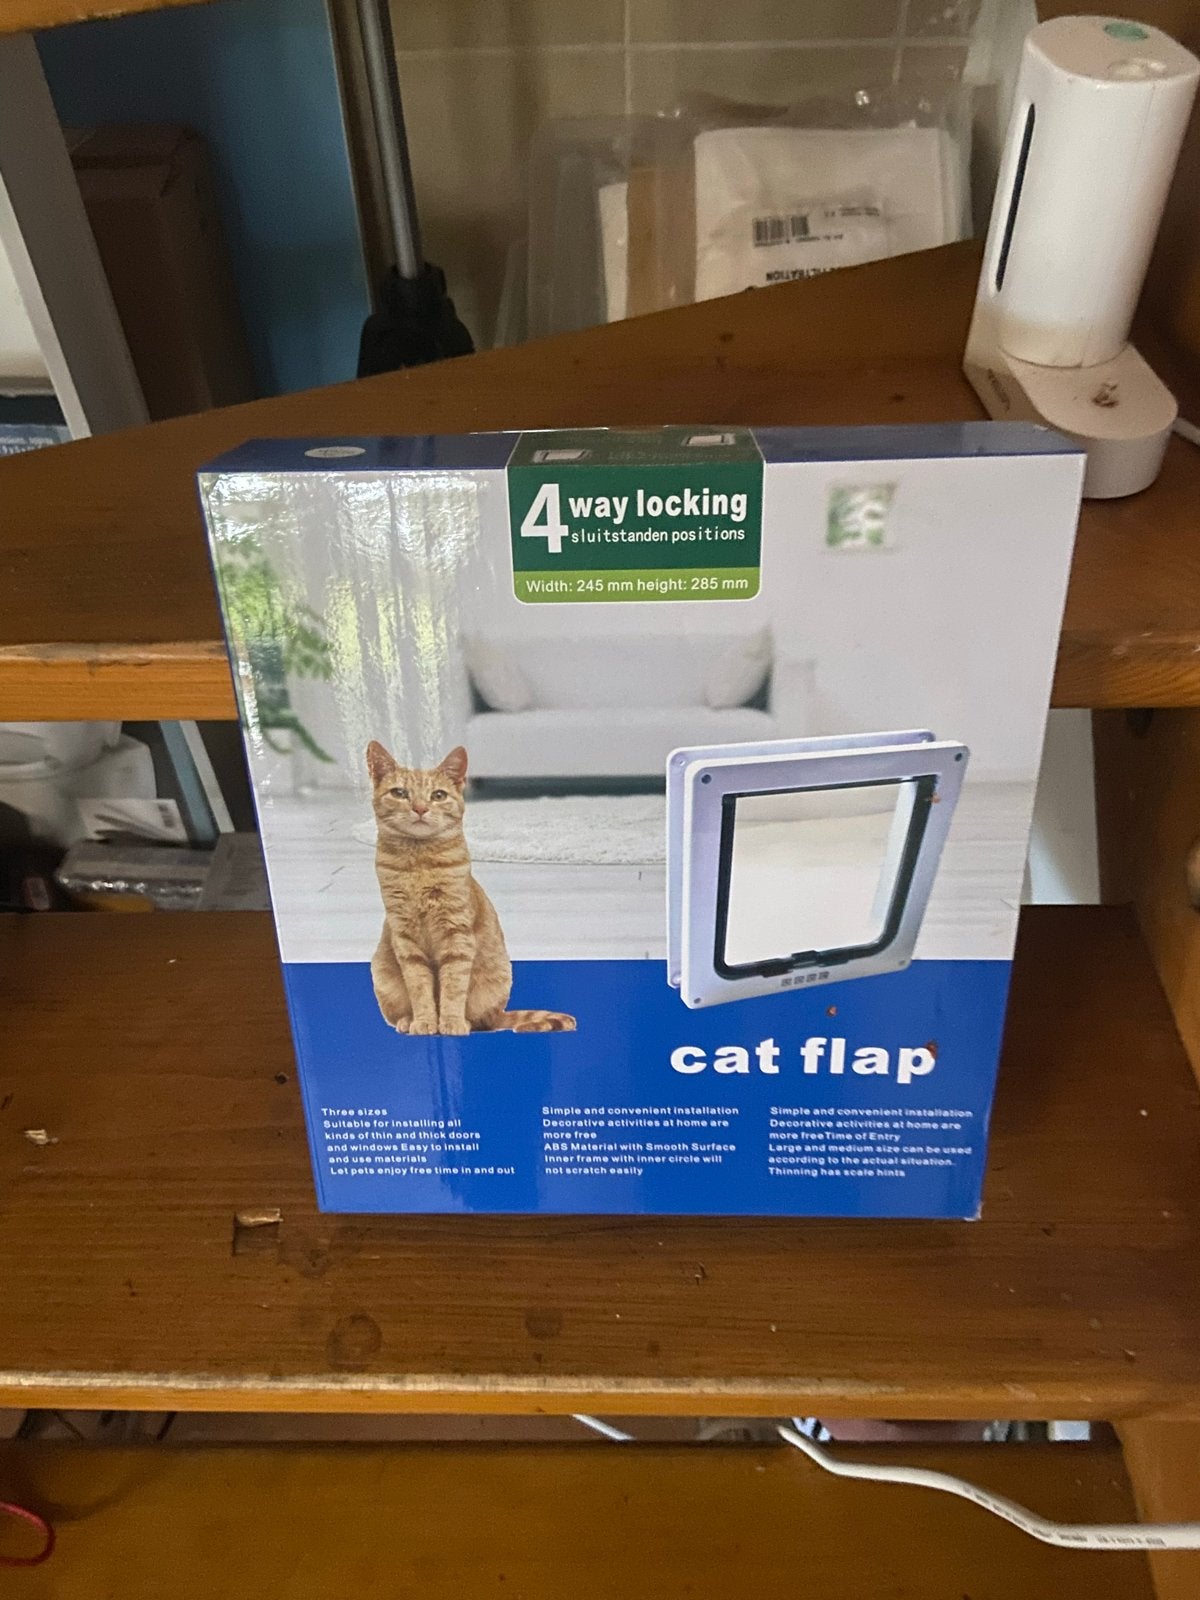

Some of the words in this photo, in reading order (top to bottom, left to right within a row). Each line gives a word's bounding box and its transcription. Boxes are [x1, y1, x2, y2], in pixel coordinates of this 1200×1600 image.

[568, 496, 629, 524] way
[637, 487, 747, 522] locking
[520, 483, 568, 553] 4
[571, 529, 668, 543] sluitstanden
[671, 526, 745, 543] positions
[526, 579, 572, 593] Width:
[577, 579, 604, 591] 245
[608, 581, 633, 591] mm
[637, 578, 687, 591] height:
[691, 577, 718, 590] 285
[722, 578, 748, 589] mm
[670, 1038, 780, 1074] cat
[800, 1037, 936, 1084] flap
[321, 1108, 355, 1116] Three
[357, 1108, 388, 1116] sizes
[542, 1107, 582, 1116] Simple
[584, 1107, 605, 1115] and
[607, 1107, 671, 1115] convenient
[673, 1107, 739, 1115] installation
[770, 1107, 811, 1116] Simple
[813, 1107, 835, 1115] and
[836, 1108, 903, 1116] convenient
[905, 1108, 973, 1118] installation
[323, 1120, 371, 1128] Suitable
[391, 1120, 444, 1128] installing
[543, 1119, 605, 1127] Decorative
[607, 1119, 660, 1127] activities
[663, 1119, 674, 1127] at
[676, 1119, 708, 1127] home
[770, 1119, 834, 1128] Decorative
[836, 1120, 890, 1128] activities
[906, 1121, 938, 1129] home
[941, 1122, 961, 1130] are
[325, 1132, 355, 1140] kinds
[358, 1132, 369, 1140] of
[574, 1131, 597, 1139] free
[769, 1132, 799, 1140] more
[855, 1132, 867, 1140] of
[869, 1132, 901, 1142] Entry
[327, 1144, 347, 1152] and
[401, 1143, 428, 1152] Easy
[444, 1143, 479, 1151] install
[544, 1143, 568, 1151] ABS
[571, 1143, 617, 1151] Material
[620, 1143, 643, 1151] with
[646, 1143, 688, 1151] Smooth
[691, 1143, 736, 1151] Surface
[768, 1144, 802, 1153] Large
[804, 1144, 826, 1152] and
[828, 1144, 873, 1153] medium
[876, 1145, 900, 1153] size
[902, 1145, 924, 1153] can
[926, 1146, 939, 1154] be
[943, 1146, 972, 1154] used
[375, 1155, 427, 1163] materials
[544, 1155, 574, 1163] Inner
[576, 1155, 609, 1163] frame
[611, 1155, 635, 1163] with
[637, 1155, 666, 1163] inner
[668, 1155, 700, 1163] circle
[702, 1155, 722, 1163] will
[768, 1155, 825, 1165] according
[828, 1156, 839, 1164] to
[841, 1156, 860, 1164] the
[862, 1157, 898, 1165] actual
[330, 1167, 348, 1175] Let
[351, 1167, 375, 1176] pets
[377, 1167, 407, 1176] enjoy
[565, 1167, 607, 1175] scratch
[609, 1167, 643, 1176] easily
[768, 1167, 818, 1177] Thinning
[821, 1168, 841, 1176] has
[844, 1168, 874, 1176] scale
[877, 1169, 906, 1177] hints
